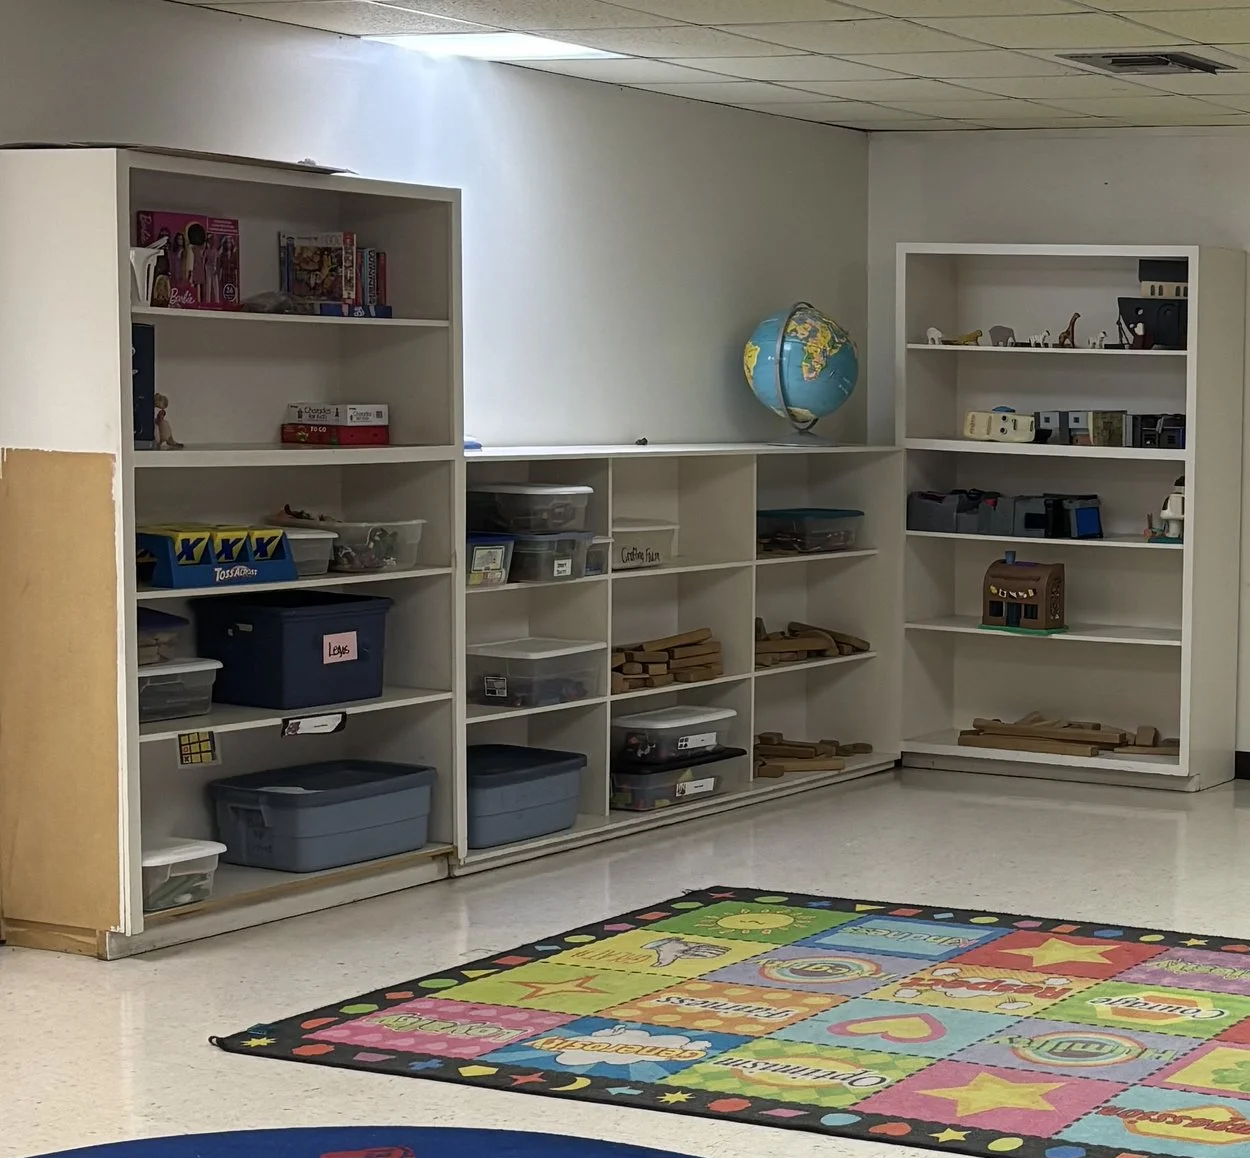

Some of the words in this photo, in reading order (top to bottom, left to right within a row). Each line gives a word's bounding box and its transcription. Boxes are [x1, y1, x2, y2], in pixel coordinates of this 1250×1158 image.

[169, 287, 196, 305] Barbie
[328, 641, 350, 658] Legos
[900, 978, 1073, 999] Respect
[655, 995, 796, 1020] Fairness
[1088, 996, 1229, 1020] Courage
[364, 1012, 531, 1041] Loyalty
[524, 1036, 706, 1061] Generosity
[713, 1057, 890, 1088] Optimism
